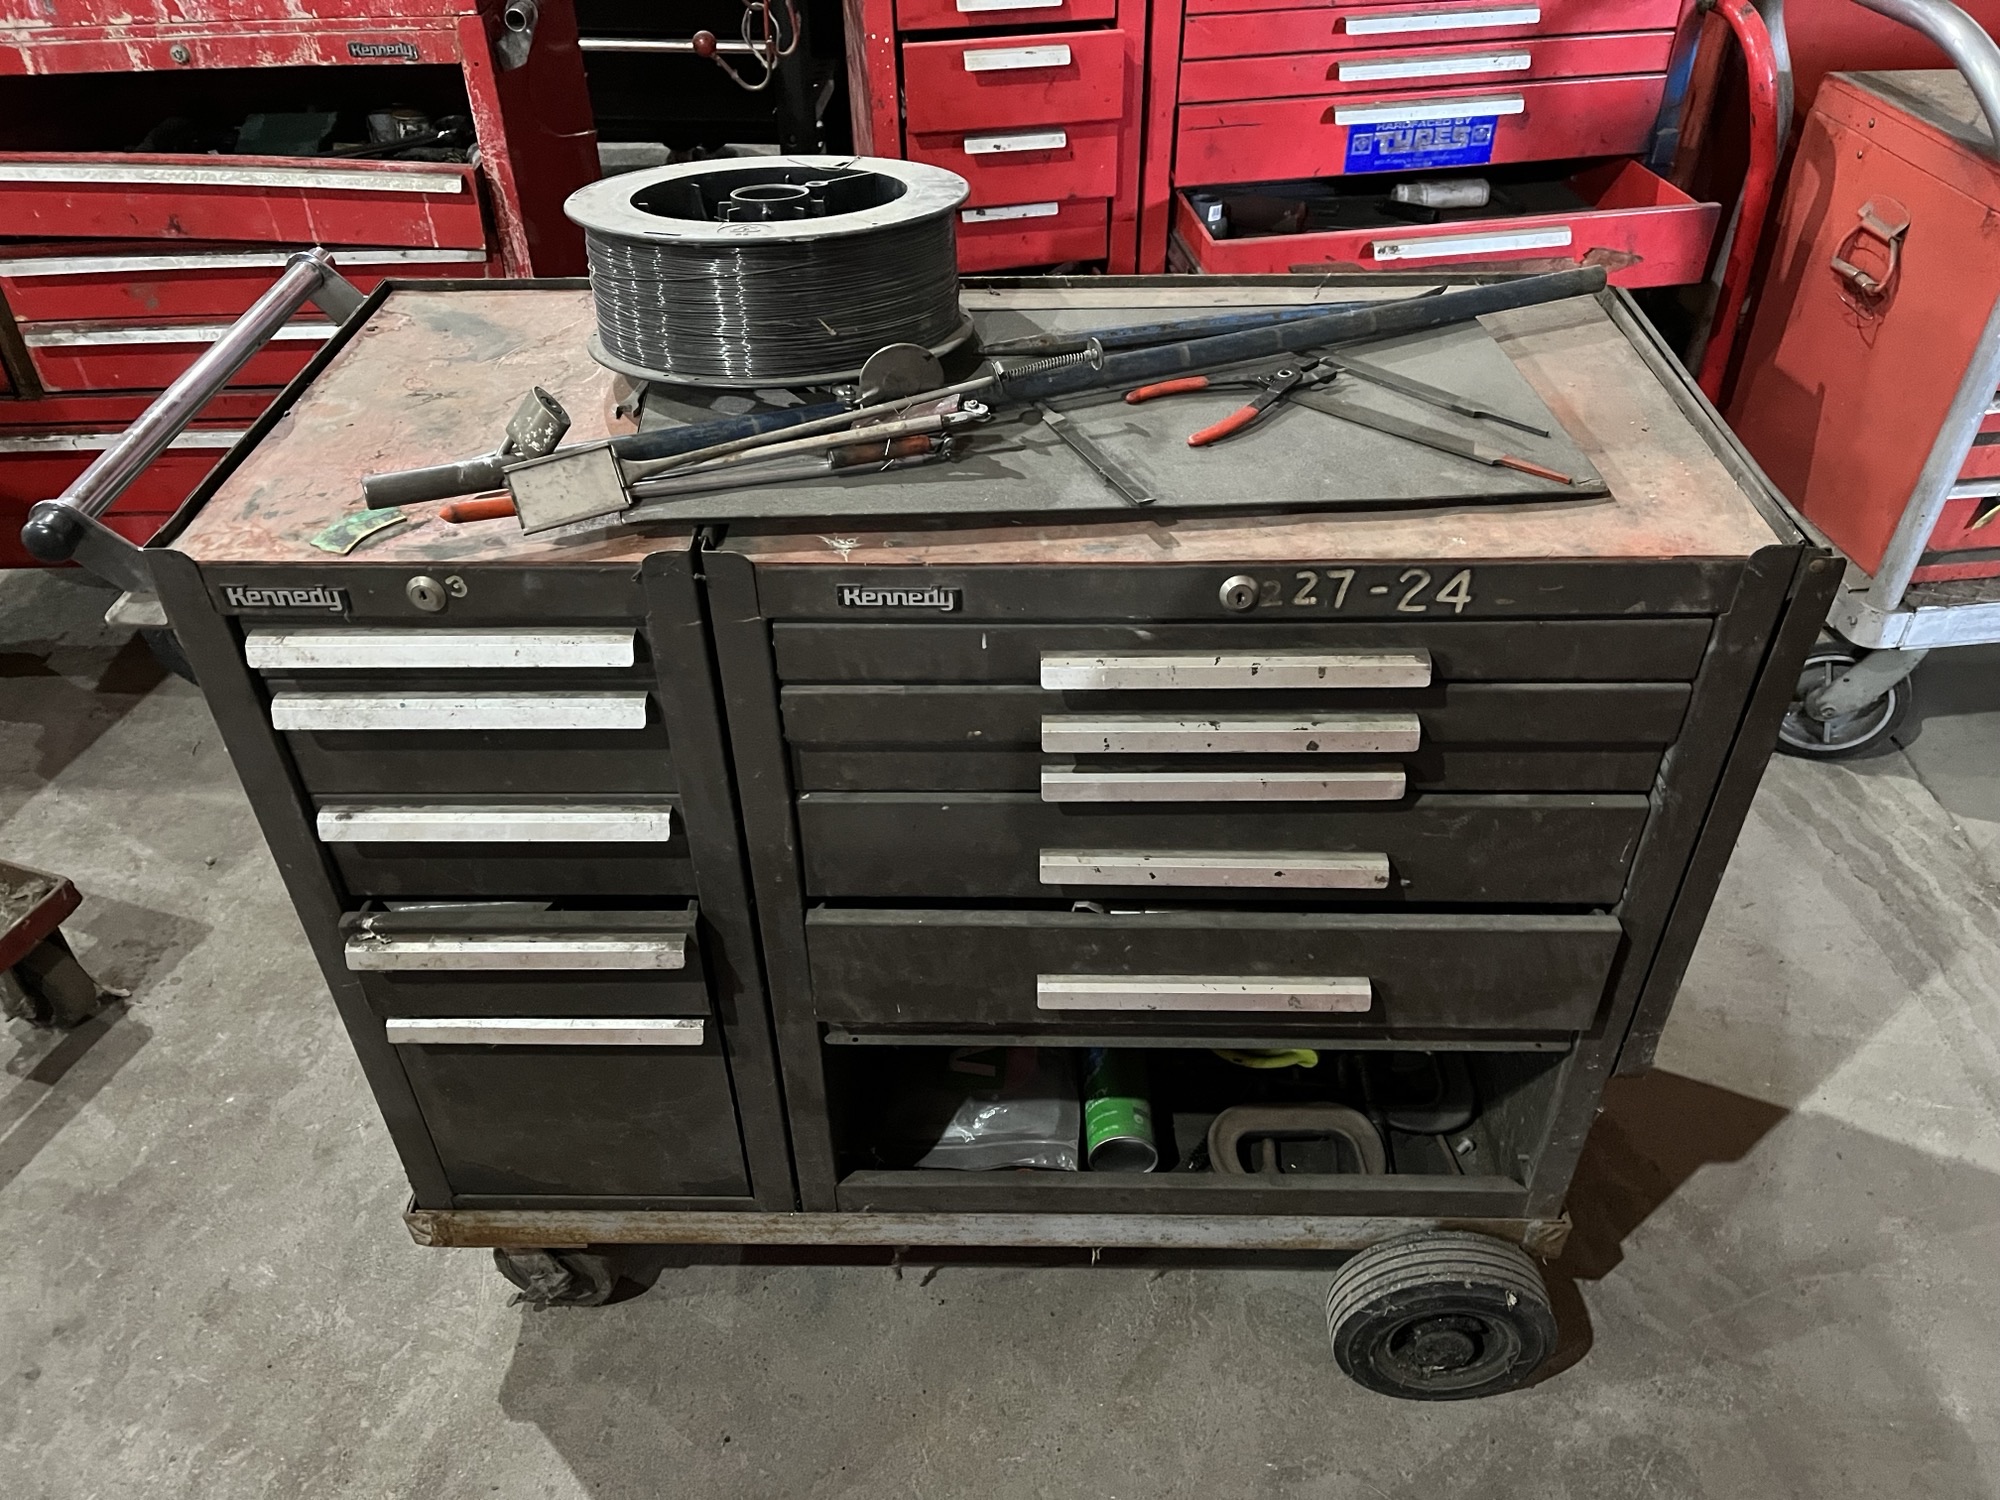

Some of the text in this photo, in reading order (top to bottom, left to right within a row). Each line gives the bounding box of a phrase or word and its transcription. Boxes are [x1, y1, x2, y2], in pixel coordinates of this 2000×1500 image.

[350, 43, 415, 59] Kennedy
[445, 575, 468, 598] 3
[226, 587, 342, 611] Kennedy
[843, 588, 954, 611] Kennedy
